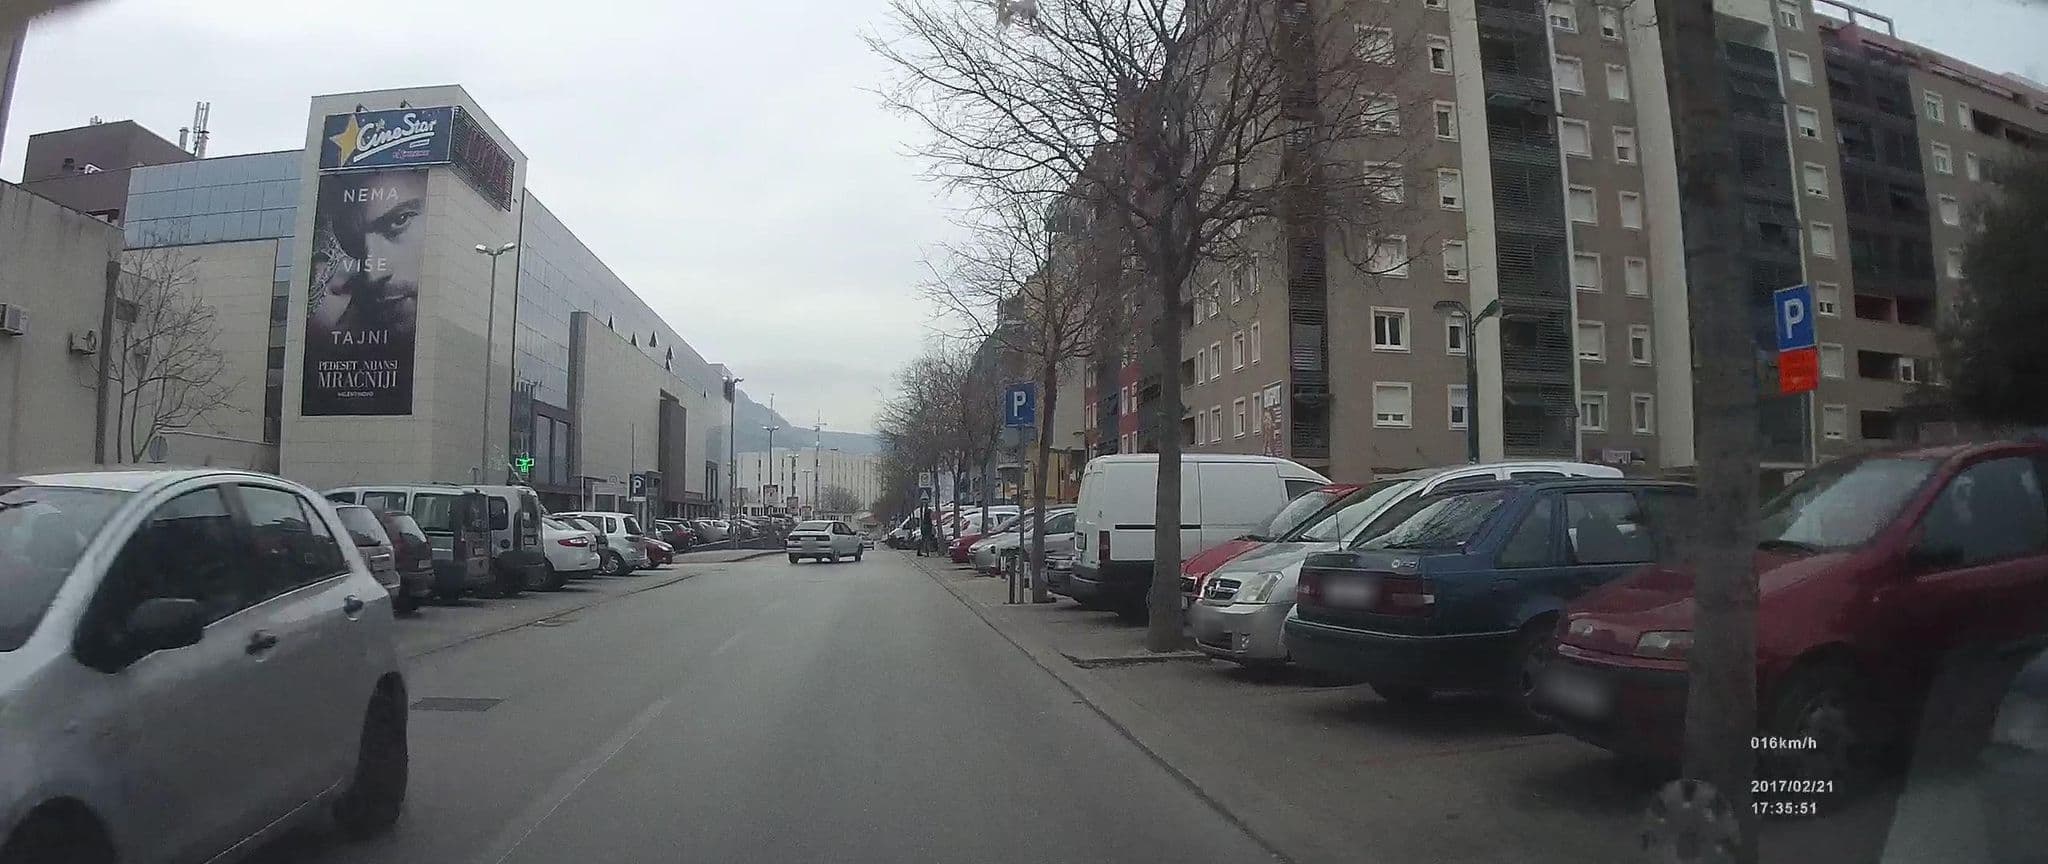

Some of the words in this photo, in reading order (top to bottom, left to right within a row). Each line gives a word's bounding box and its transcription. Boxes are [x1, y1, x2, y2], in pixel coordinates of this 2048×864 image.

[356, 112, 437, 152] CineStar
[343, 187, 399, 203] NEMA
[343, 254, 387, 272] VIŠE
[1784, 298, 1804, 339] P
[331, 329, 388, 345] TAJNI
[318, 360, 358, 371] PEDESET
[1013, 390, 1027, 417] P
[632, 479, 642, 494] P
